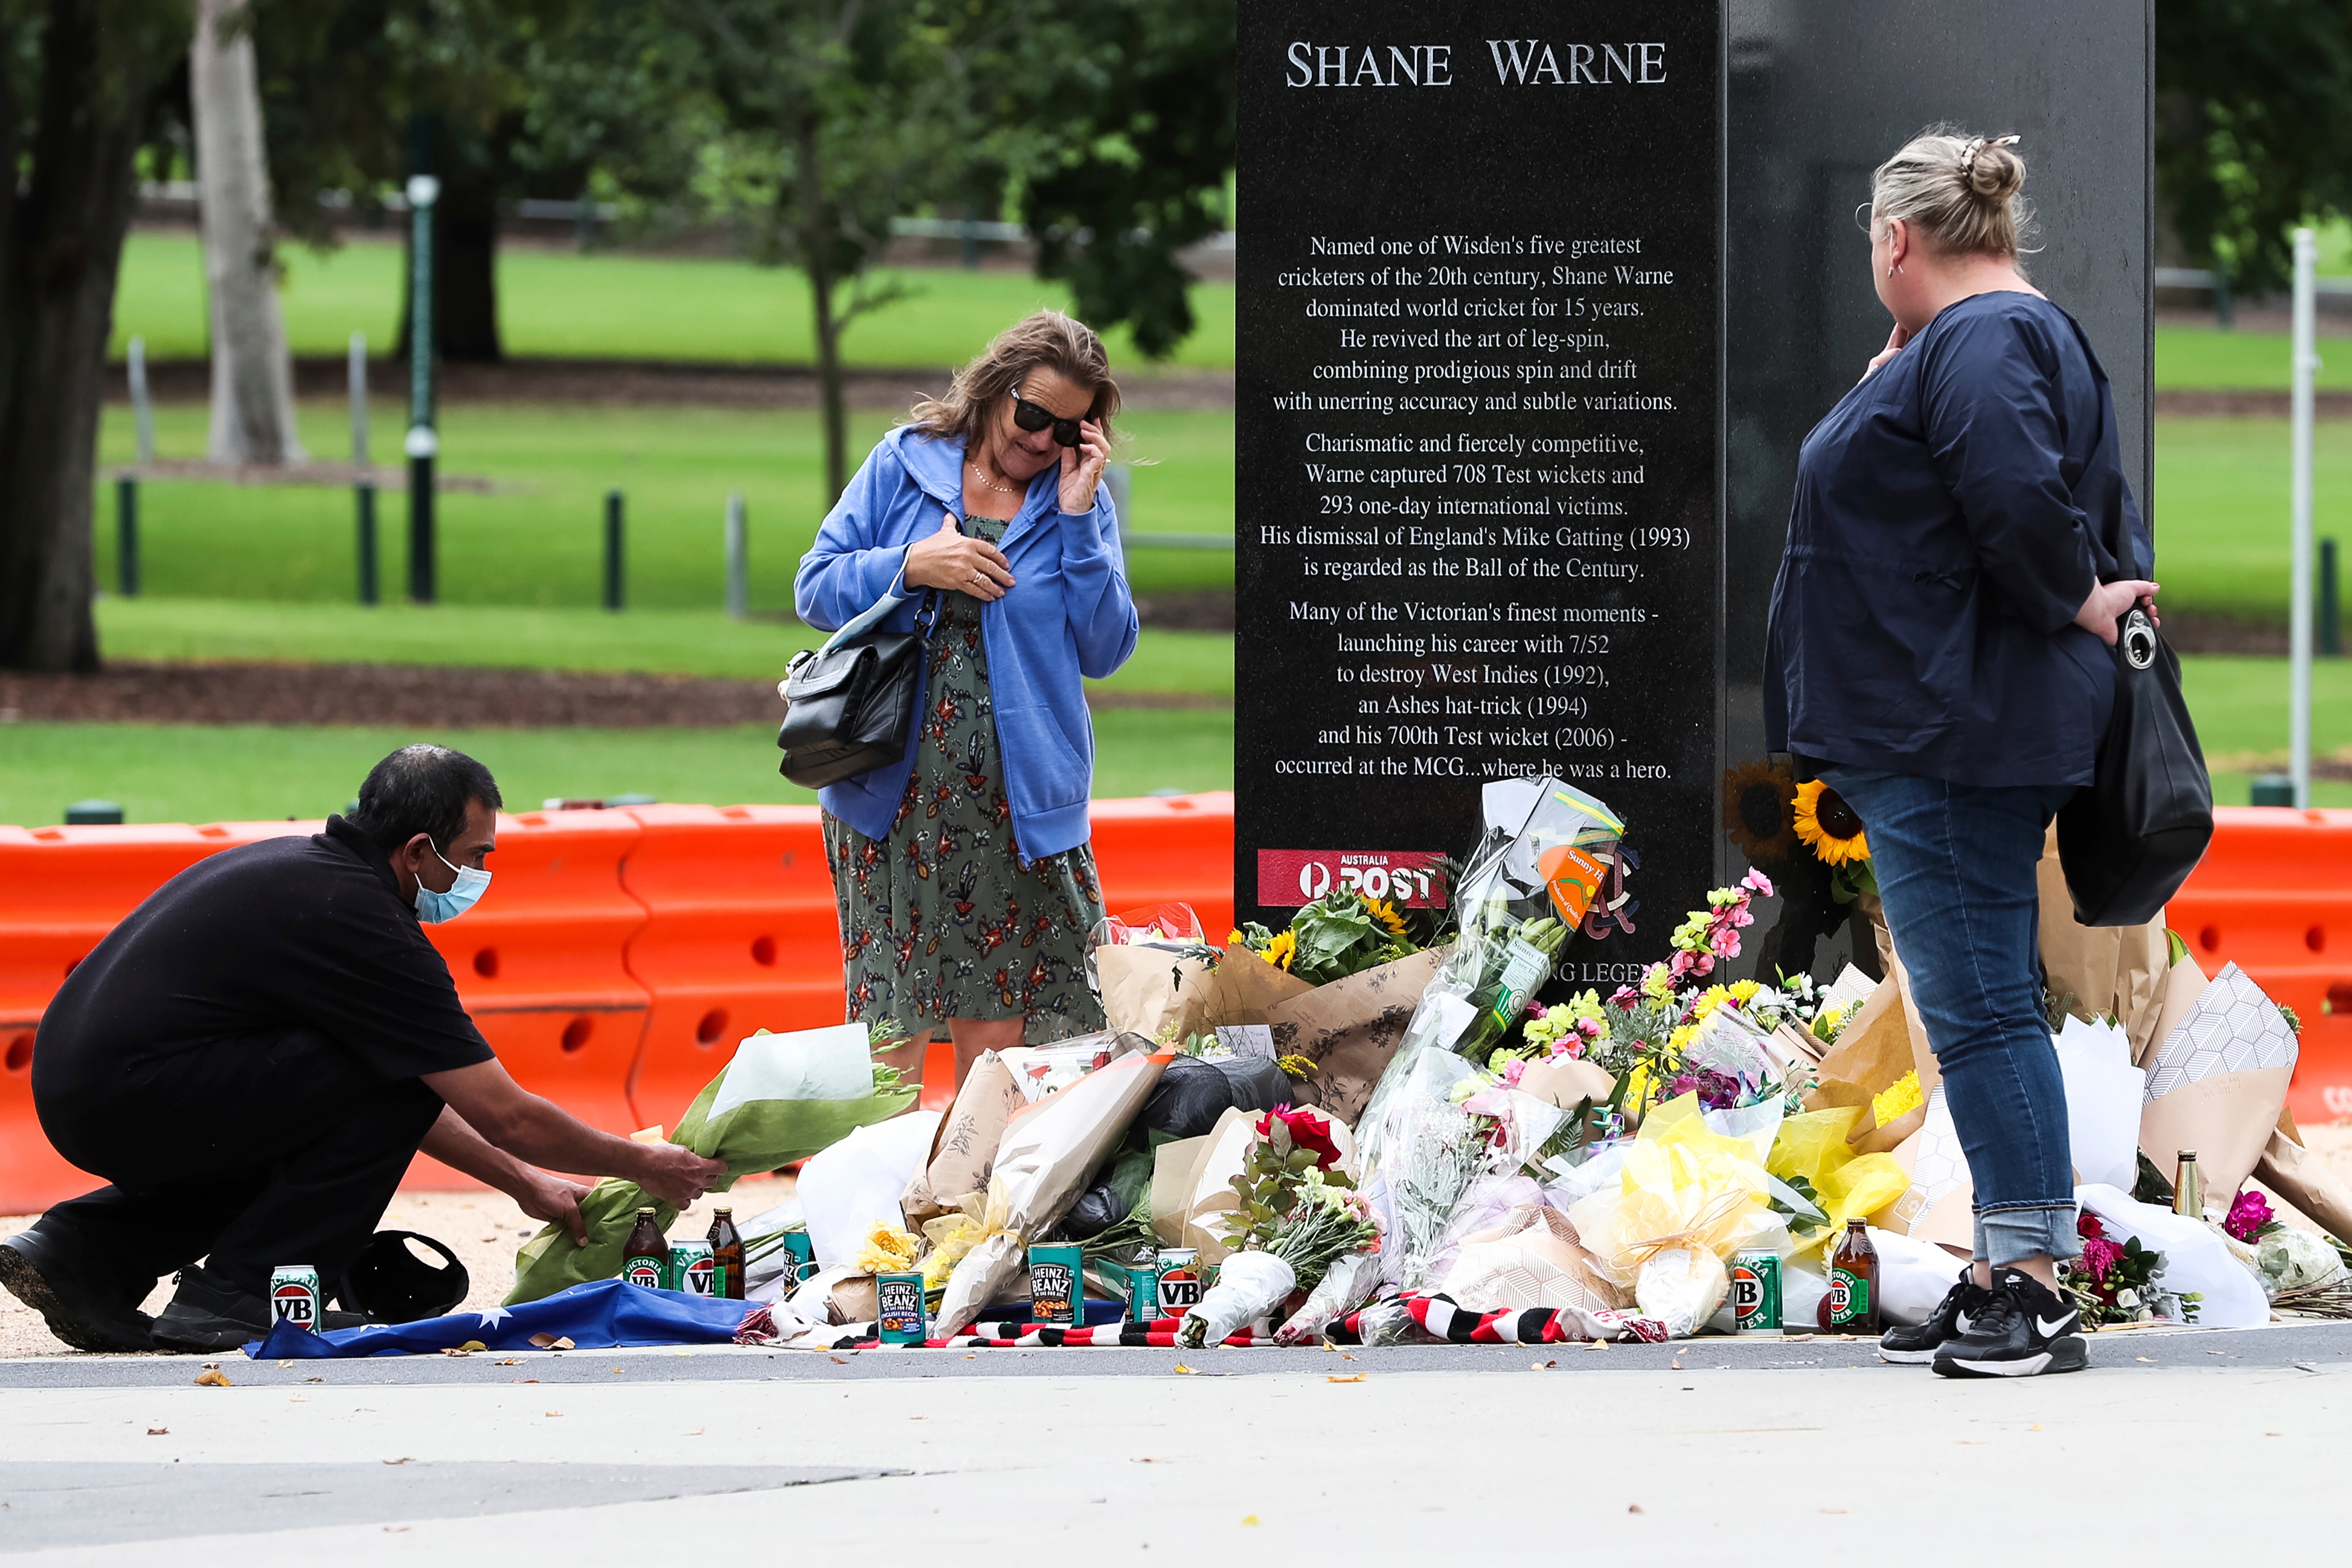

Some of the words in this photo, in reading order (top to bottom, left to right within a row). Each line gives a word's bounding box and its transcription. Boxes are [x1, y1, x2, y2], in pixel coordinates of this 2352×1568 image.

[1286, 41, 1452, 87] SHANE
[1485, 39, 1667, 85] WARNE
[1310, 236, 1375, 255] Named
[1381, 241, 1413, 255] one
[1419, 235, 1439, 255] of
[1443, 235, 1524, 254] Wisden's
[1530, 234, 1565, 254] five
[1571, 237, 1641, 259] greatest
[1278, 267, 1365, 286] cricketers
[1370, 266, 1391, 285] of
[1395, 267, 1422, 285] the
[1428, 266, 1467, 285] 20th
[1473, 269, 1546, 290] century,
[1552, 266, 1608, 285] Shane
[1613, 265, 1673, 285] Warne
[1306, 298, 1400, 317] dominated
[1406, 298, 1458, 317] world
[1464, 298, 1525, 317] cricket
[1531, 297, 1558, 316] for
[1565, 296, 1585, 316] 15
[1592, 302, 1644, 321] years.
[1340, 328, 1367, 348] He
[1372, 328, 1439, 347] revived
[1445, 328, 1472, 347] the
[1477, 331, 1501, 347] art
[1507, 328, 1527, 347] of
[1532, 328, 1610, 352] leg-spin,
[1313, 359, 1409, 384] combining
[1414, 359, 1510, 384] prodigious
[1517, 359, 1553, 384] spin
[1560, 359, 1592, 379] and
[1598, 359, 1637, 379] drift
[1273, 391, 1312, 410] with
[1318, 390, 1394, 415] unerring
[1399, 396, 1479, 416] accuracy
[1485, 391, 1517, 410] and
[1523, 391, 1577, 410] subtle
[1583, 391, 1677, 410] variations.
[1306, 433, 1414, 452] Charismatic
[1419, 433, 1452, 452] and
[1457, 433, 1526, 458] fiercely
[1532, 434, 1644, 458] competitive,
[1305, 462, 1365, 483] Warne
[1370, 464, 1447, 488] captured
[1453, 464, 1486, 483] 708
[1492, 465, 1532, 483] Test
[1537, 465, 1606, 484] wickets
[1612, 465, 1644, 484] and
[1320, 495, 1353, 514] 293
[1359, 495, 1431, 520] one-day
[1437, 495, 1550, 515] international
[1556, 496, 1628, 515] victims.
[1260, 525, 1290, 544] His
[1296, 525, 1379, 545] dismissal
[1385, 526, 1405, 545] of
[1409, 526, 1496, 551] England's
[1502, 526, 1550, 546] Mike
[1556, 527, 1623, 552] Gatting
[1630, 527, 1690, 551] (1993)
[1304, 556, 1318, 575] is
[1324, 557, 1402, 581] regarded
[1408, 562, 1426, 576] as
[1432, 557, 1459, 576] the
[1465, 557, 1502, 577] Ball
[1508, 557, 1529, 577] of
[1533, 558, 1560, 577] the
[1566, 558, 1644, 583] Century.
[1289, 601, 1340, 626] Many
[1347, 601, 1367, 621] of
[1371, 602, 1398, 621] the
[1403, 601, 1501, 621] Victorian's
[1507, 602, 1557, 622] finest
[1563, 606, 1646, 622] moments
[1338, 633, 1425, 657] launching
[1431, 633, 1457, 652] his
[1463, 639, 1518, 653] career
[1524, 634, 1563, 653] with
[1569, 634, 1609, 653] 7/52
[1337, 666, 1354, 682] to
[1360, 664, 1425, 688] destroy
[1431, 664, 1477, 683] West
[1483, 664, 1538, 684] Indies
[1544, 665, 1609, 688] (1992),
[1358, 700, 1379, 713] an
[1385, 695, 1439, 714] Ashes
[1445, 695, 1522, 715] hat-trick
[1528, 696, 1587, 719] (1994)
[1318, 725, 1350, 744] and
[1356, 725, 1382, 744] his
[1387, 725, 1439, 745] 700th
[1444, 726, 1483, 745] Test
[1489, 726, 1549, 746] wicket
[1555, 727, 1614, 750] (2006)
[1275, 756, 1353, 775] occurred
[1359, 759, 1375, 775] at
[1380, 756, 1407, 775] the
[1413, 756, 1536, 777] MCG...where
[1543, 759, 1563, 777] he
[1570, 763, 1604, 778] was
[1610, 764, 1620, 778] a
[1626, 760, 1671, 779] hero.
[1341, 855, 1388, 865] AUSTRALIA
[1567, 850, 1594, 874] Sunny
[1340, 867, 1436, 900] POST
[1512, 940, 1535, 960] Sunny
[626, 1259, 662, 1274] VICTORIA
[1034, 1268, 1063, 1279] HEINZ
[632, 1276, 656, 1288] VB
[884, 1285, 911, 1296] HEINZ
[1032, 1279, 1069, 1293] BEANZ
[1160, 1283, 1200, 1305] VB
[274, 1299, 312, 1320] VB
[881, 1294, 916, 1308] BEANZ
